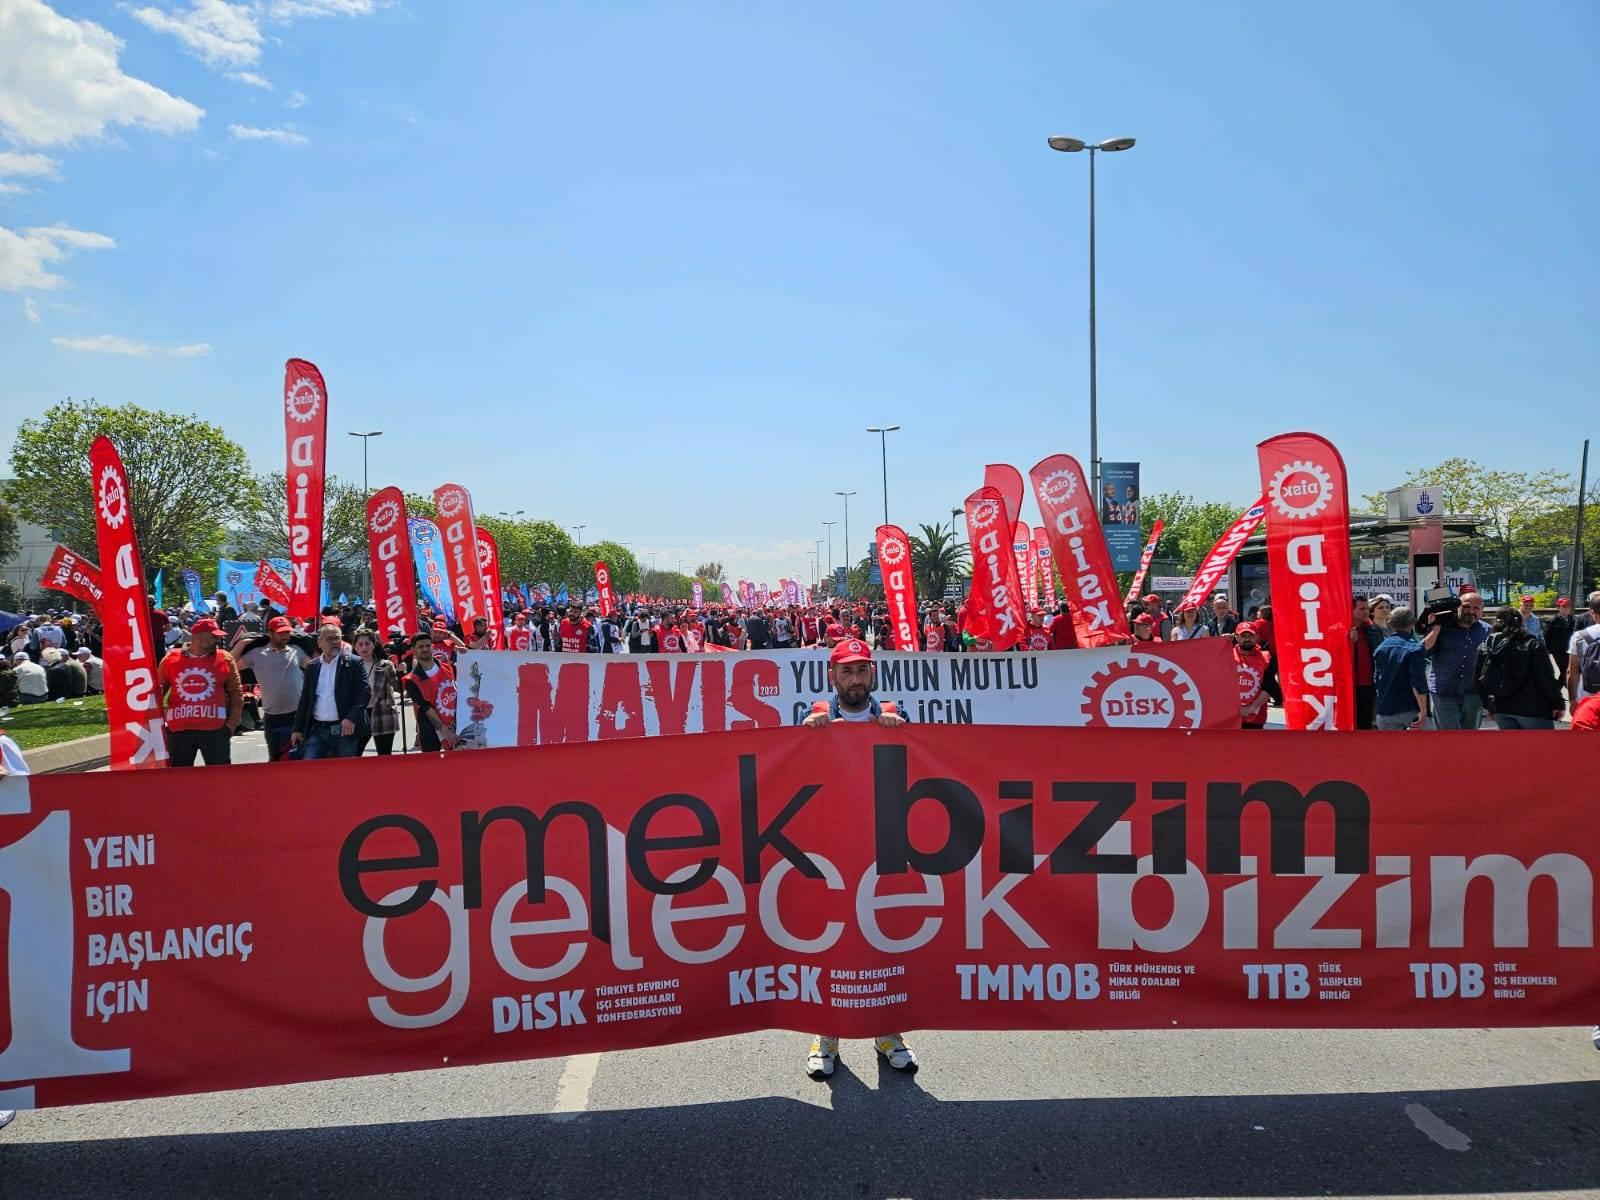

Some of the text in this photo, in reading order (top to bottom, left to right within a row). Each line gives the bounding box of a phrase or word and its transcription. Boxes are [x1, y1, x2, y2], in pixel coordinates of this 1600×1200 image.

[951, 657, 1039, 691] MUTLU
[174, 703, 217, 719] GÖREVLİ
[516, 658, 781, 746] MAYIS
[338, 744, 1371, 945] emek bizim
[361, 820, 1594, 1030] gelecek bizim
[87, 921, 254, 971] BAŞLANGIÇ
[830, 969, 857, 980] KAMU
[955, 963, 1101, 1001] TMMOB
[1108, 962, 1132, 974] TÜRK
[1183, 964, 1196, 975] VE
[1140, 976, 1180, 987] ODALARI
[1242, 963, 1311, 1000] TTB
[1318, 962, 1342, 973] TÜRK
[1409, 962, 1486, 999] TDB
[1493, 961, 1518, 972] TÜRK
[728, 963, 823, 1007] KESK
[831, 993, 908, 1008] KONFEDERASYONU
[596, 1005, 682, 1024] KONFEDERASYONU
